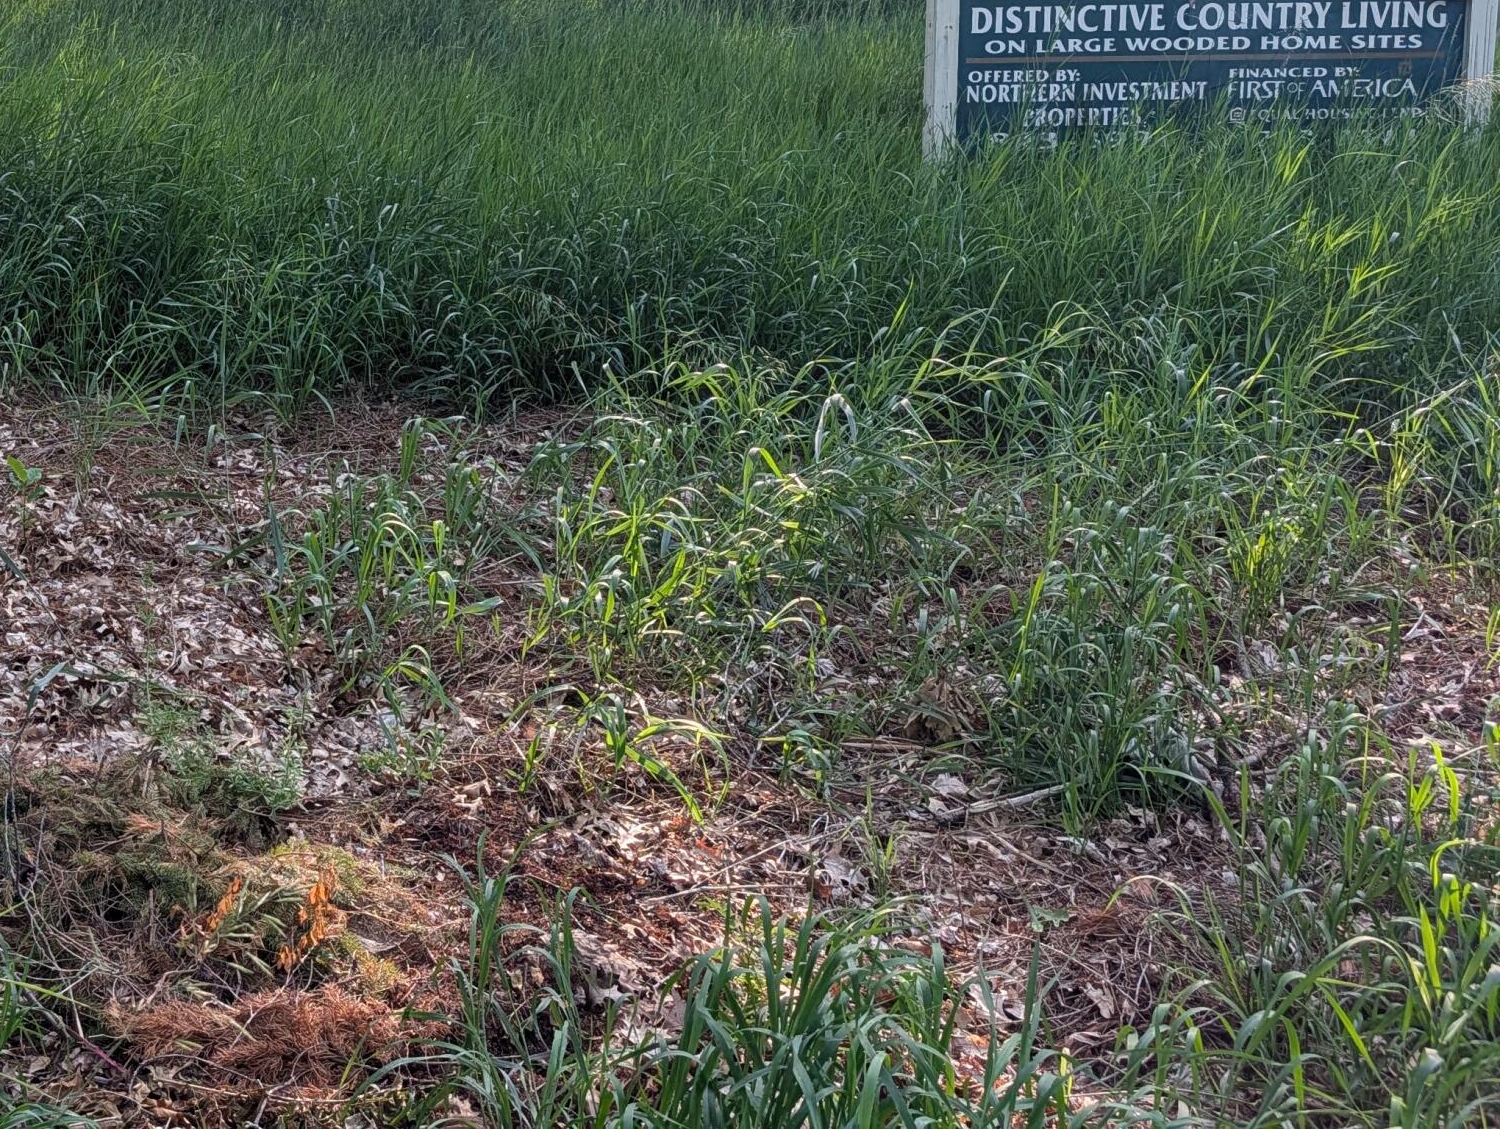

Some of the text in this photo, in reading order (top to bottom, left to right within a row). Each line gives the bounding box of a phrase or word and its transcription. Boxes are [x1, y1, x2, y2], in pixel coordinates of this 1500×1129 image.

[970, 0, 1448, 34] DISTINCTIVE COUNTRY LIVING
[984, 34, 1423, 54] ON LARGE WOODED HOME SITES
[968, 69, 1081, 83] OFFERED BY:
[1228, 66, 1361, 78] FINANCED BY:
[966, 81, 1208, 103] NORTHERN INVESTMENT
[1228, 79, 1418, 100] FIRST OF AMERICA
[1251, 109, 1299, 122] QUAL
